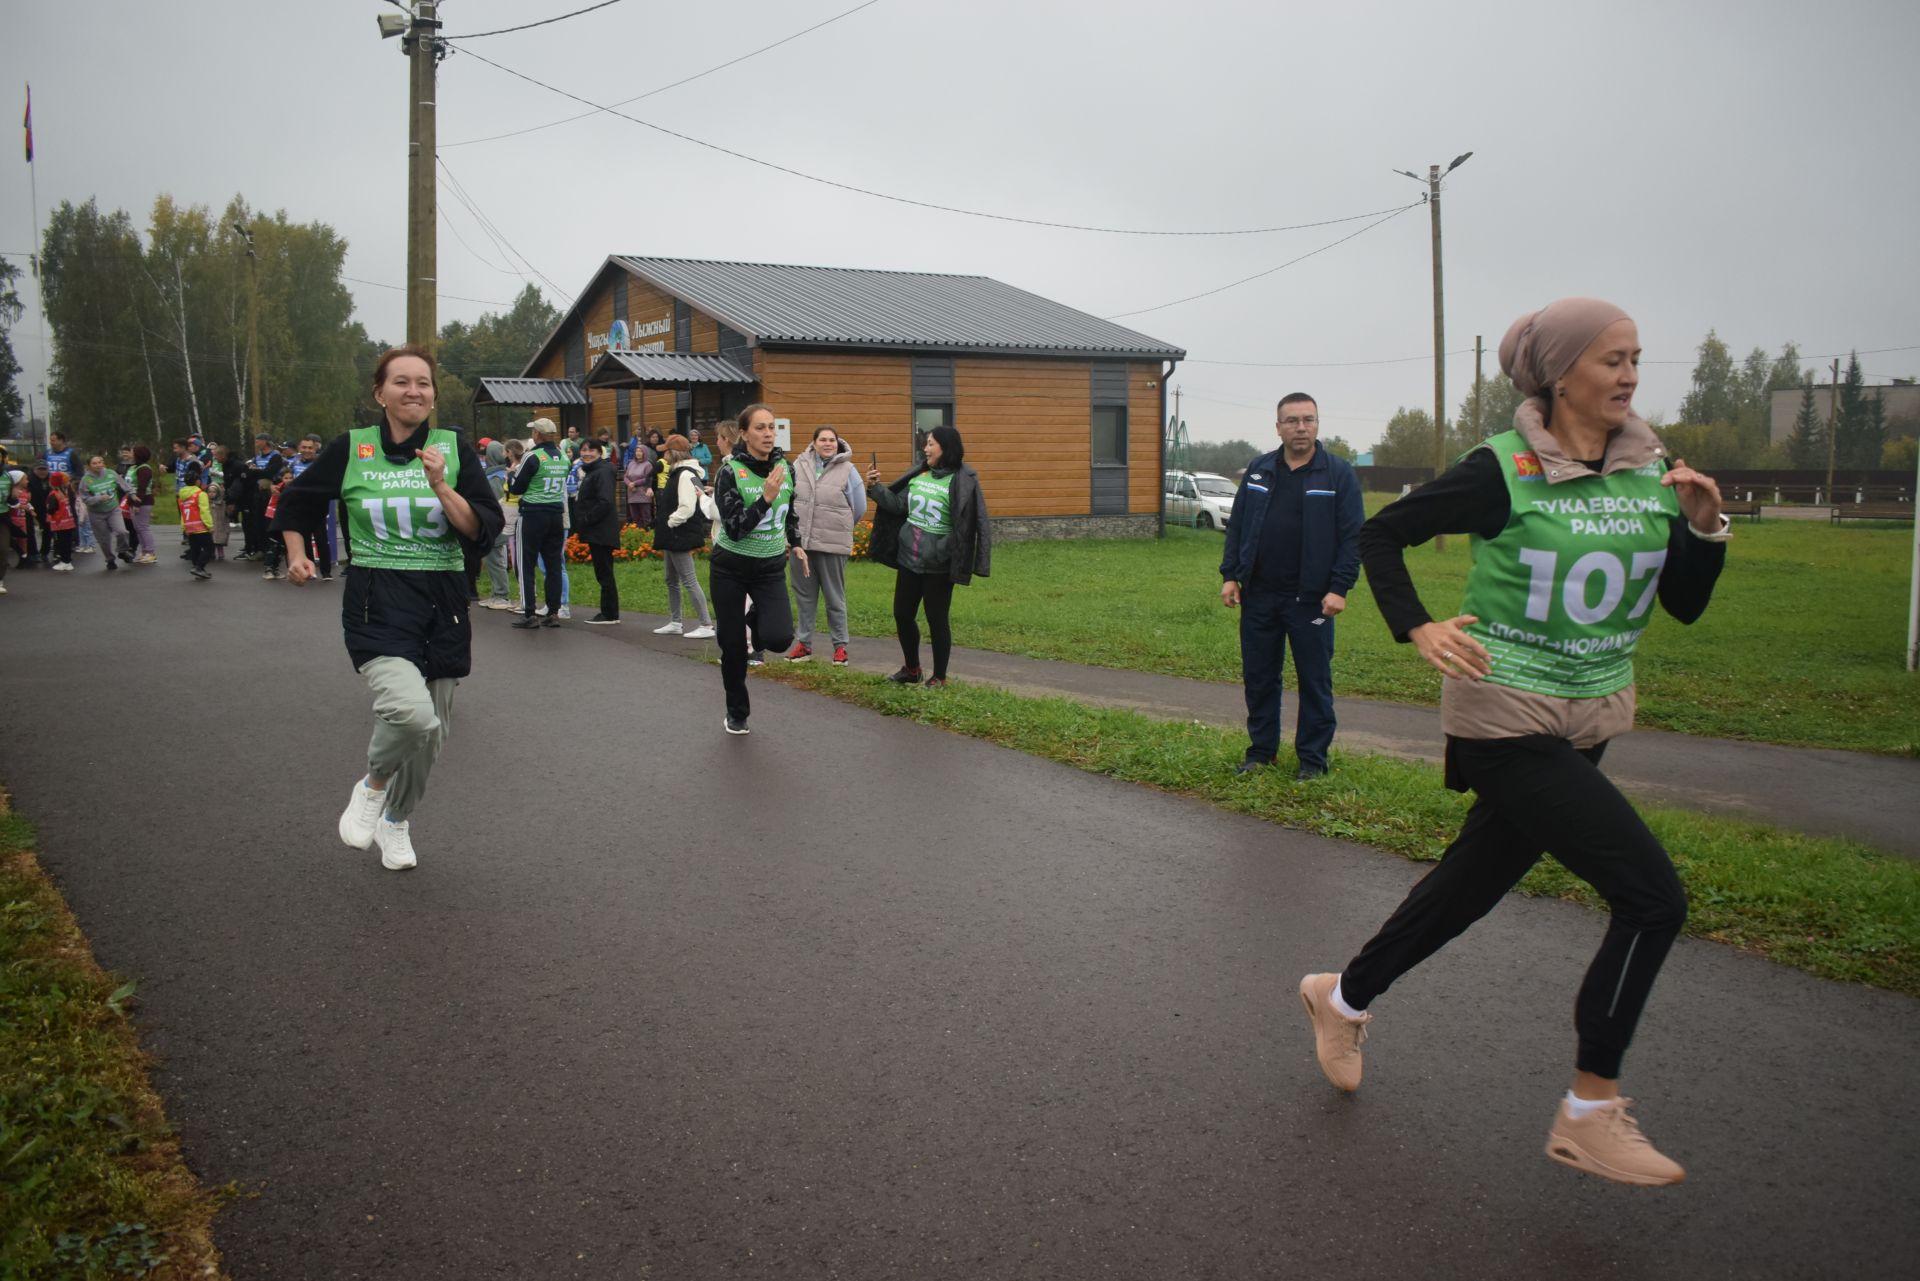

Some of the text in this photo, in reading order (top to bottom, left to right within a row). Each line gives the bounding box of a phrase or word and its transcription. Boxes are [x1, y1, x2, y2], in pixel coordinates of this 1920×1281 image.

[362, 467, 449, 481] ТУКАЕВС
[382, 477, 431, 490] РАЙОН
[1531, 496, 1666, 515] ТУКАЕВСКИЙ
[361, 496, 449, 540] 113
[1571, 514, 1646, 535] РАЙОН
[1518, 547, 1668, 626] 107
[1488, 622, 1549, 647] СПОРТ
